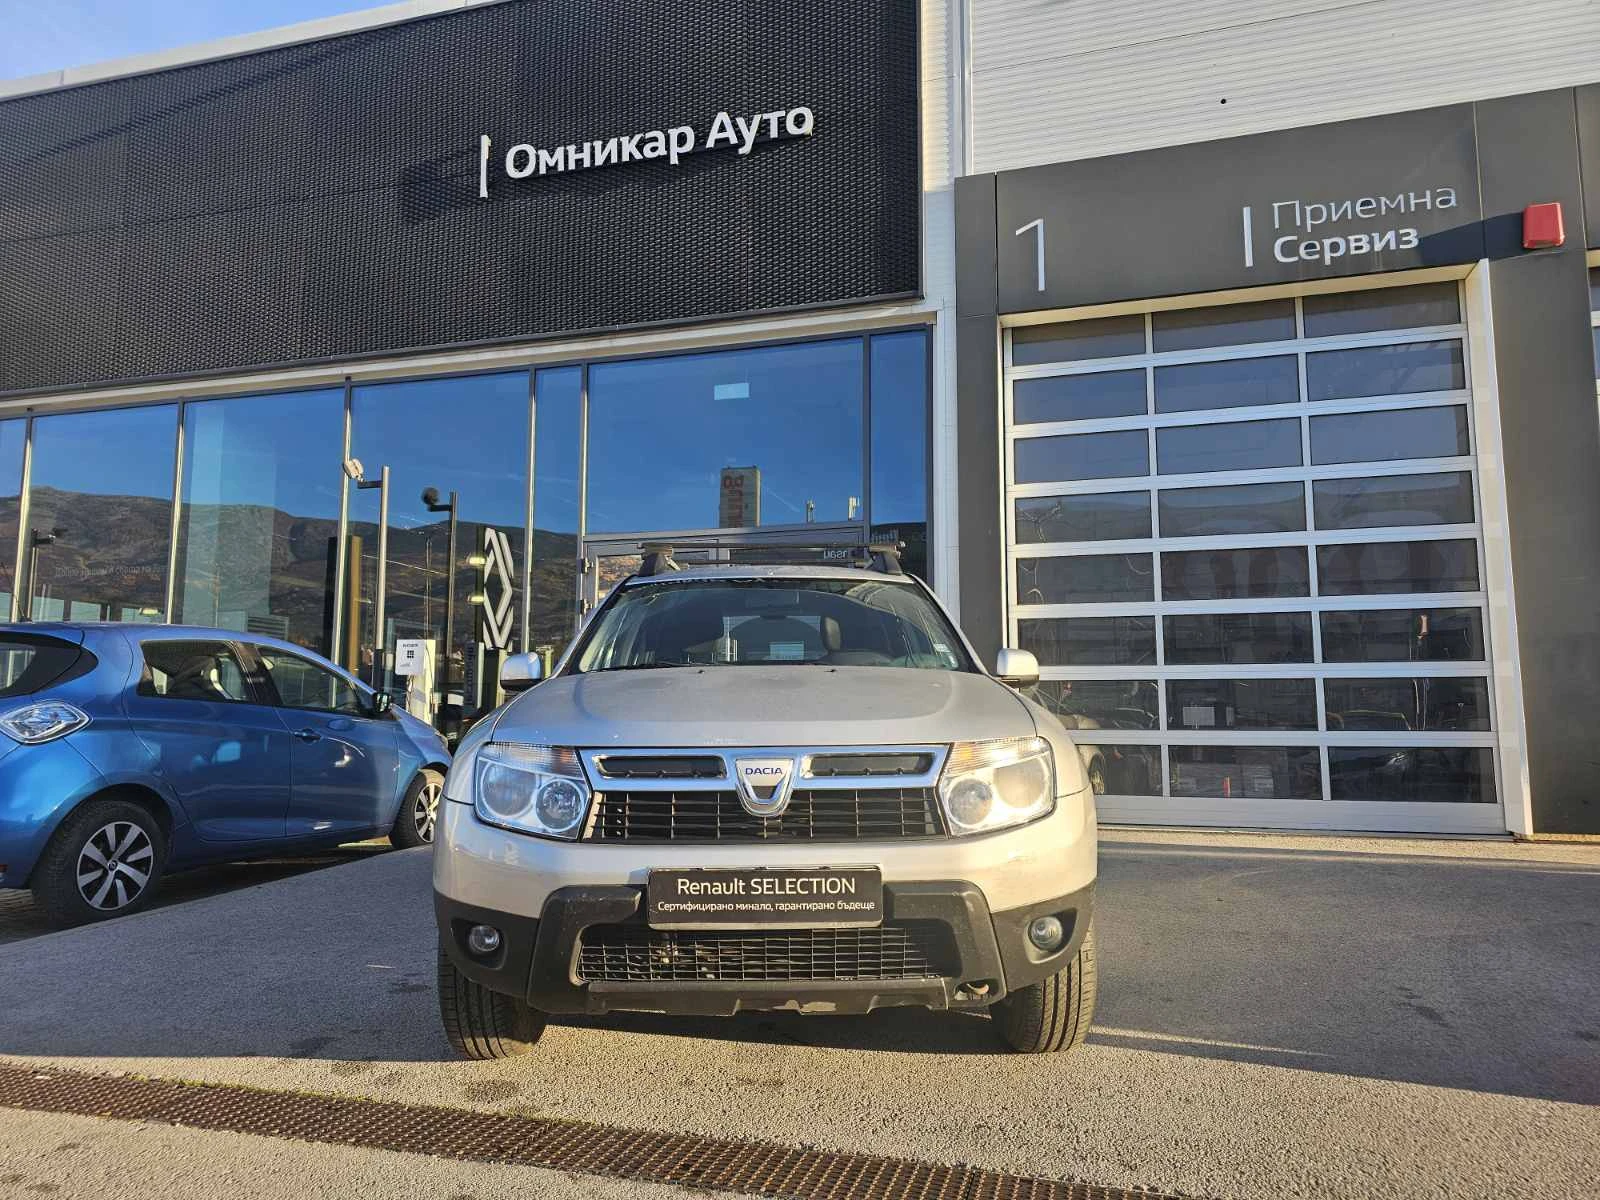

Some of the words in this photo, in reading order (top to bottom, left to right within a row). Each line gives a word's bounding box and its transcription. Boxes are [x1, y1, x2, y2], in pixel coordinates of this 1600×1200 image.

[505, 125, 695, 178] Омникар
[705, 106, 814, 154] Ауто
[1272, 187, 1458, 232] Приемна
[1015, 218, 1046, 292] 1
[1273, 228, 1419, 265] Сервиз
[745, 767, 783, 775] DACIA
[677, 877, 746, 895] Renault
[750, 877, 856, 895] SELECTION
[657, 901, 734, 912] Сертифицирано
[735, 902, 774, 912] минало,
[775, 901, 835, 912] гарантирано
[837, 900, 875, 911] бъдеще
